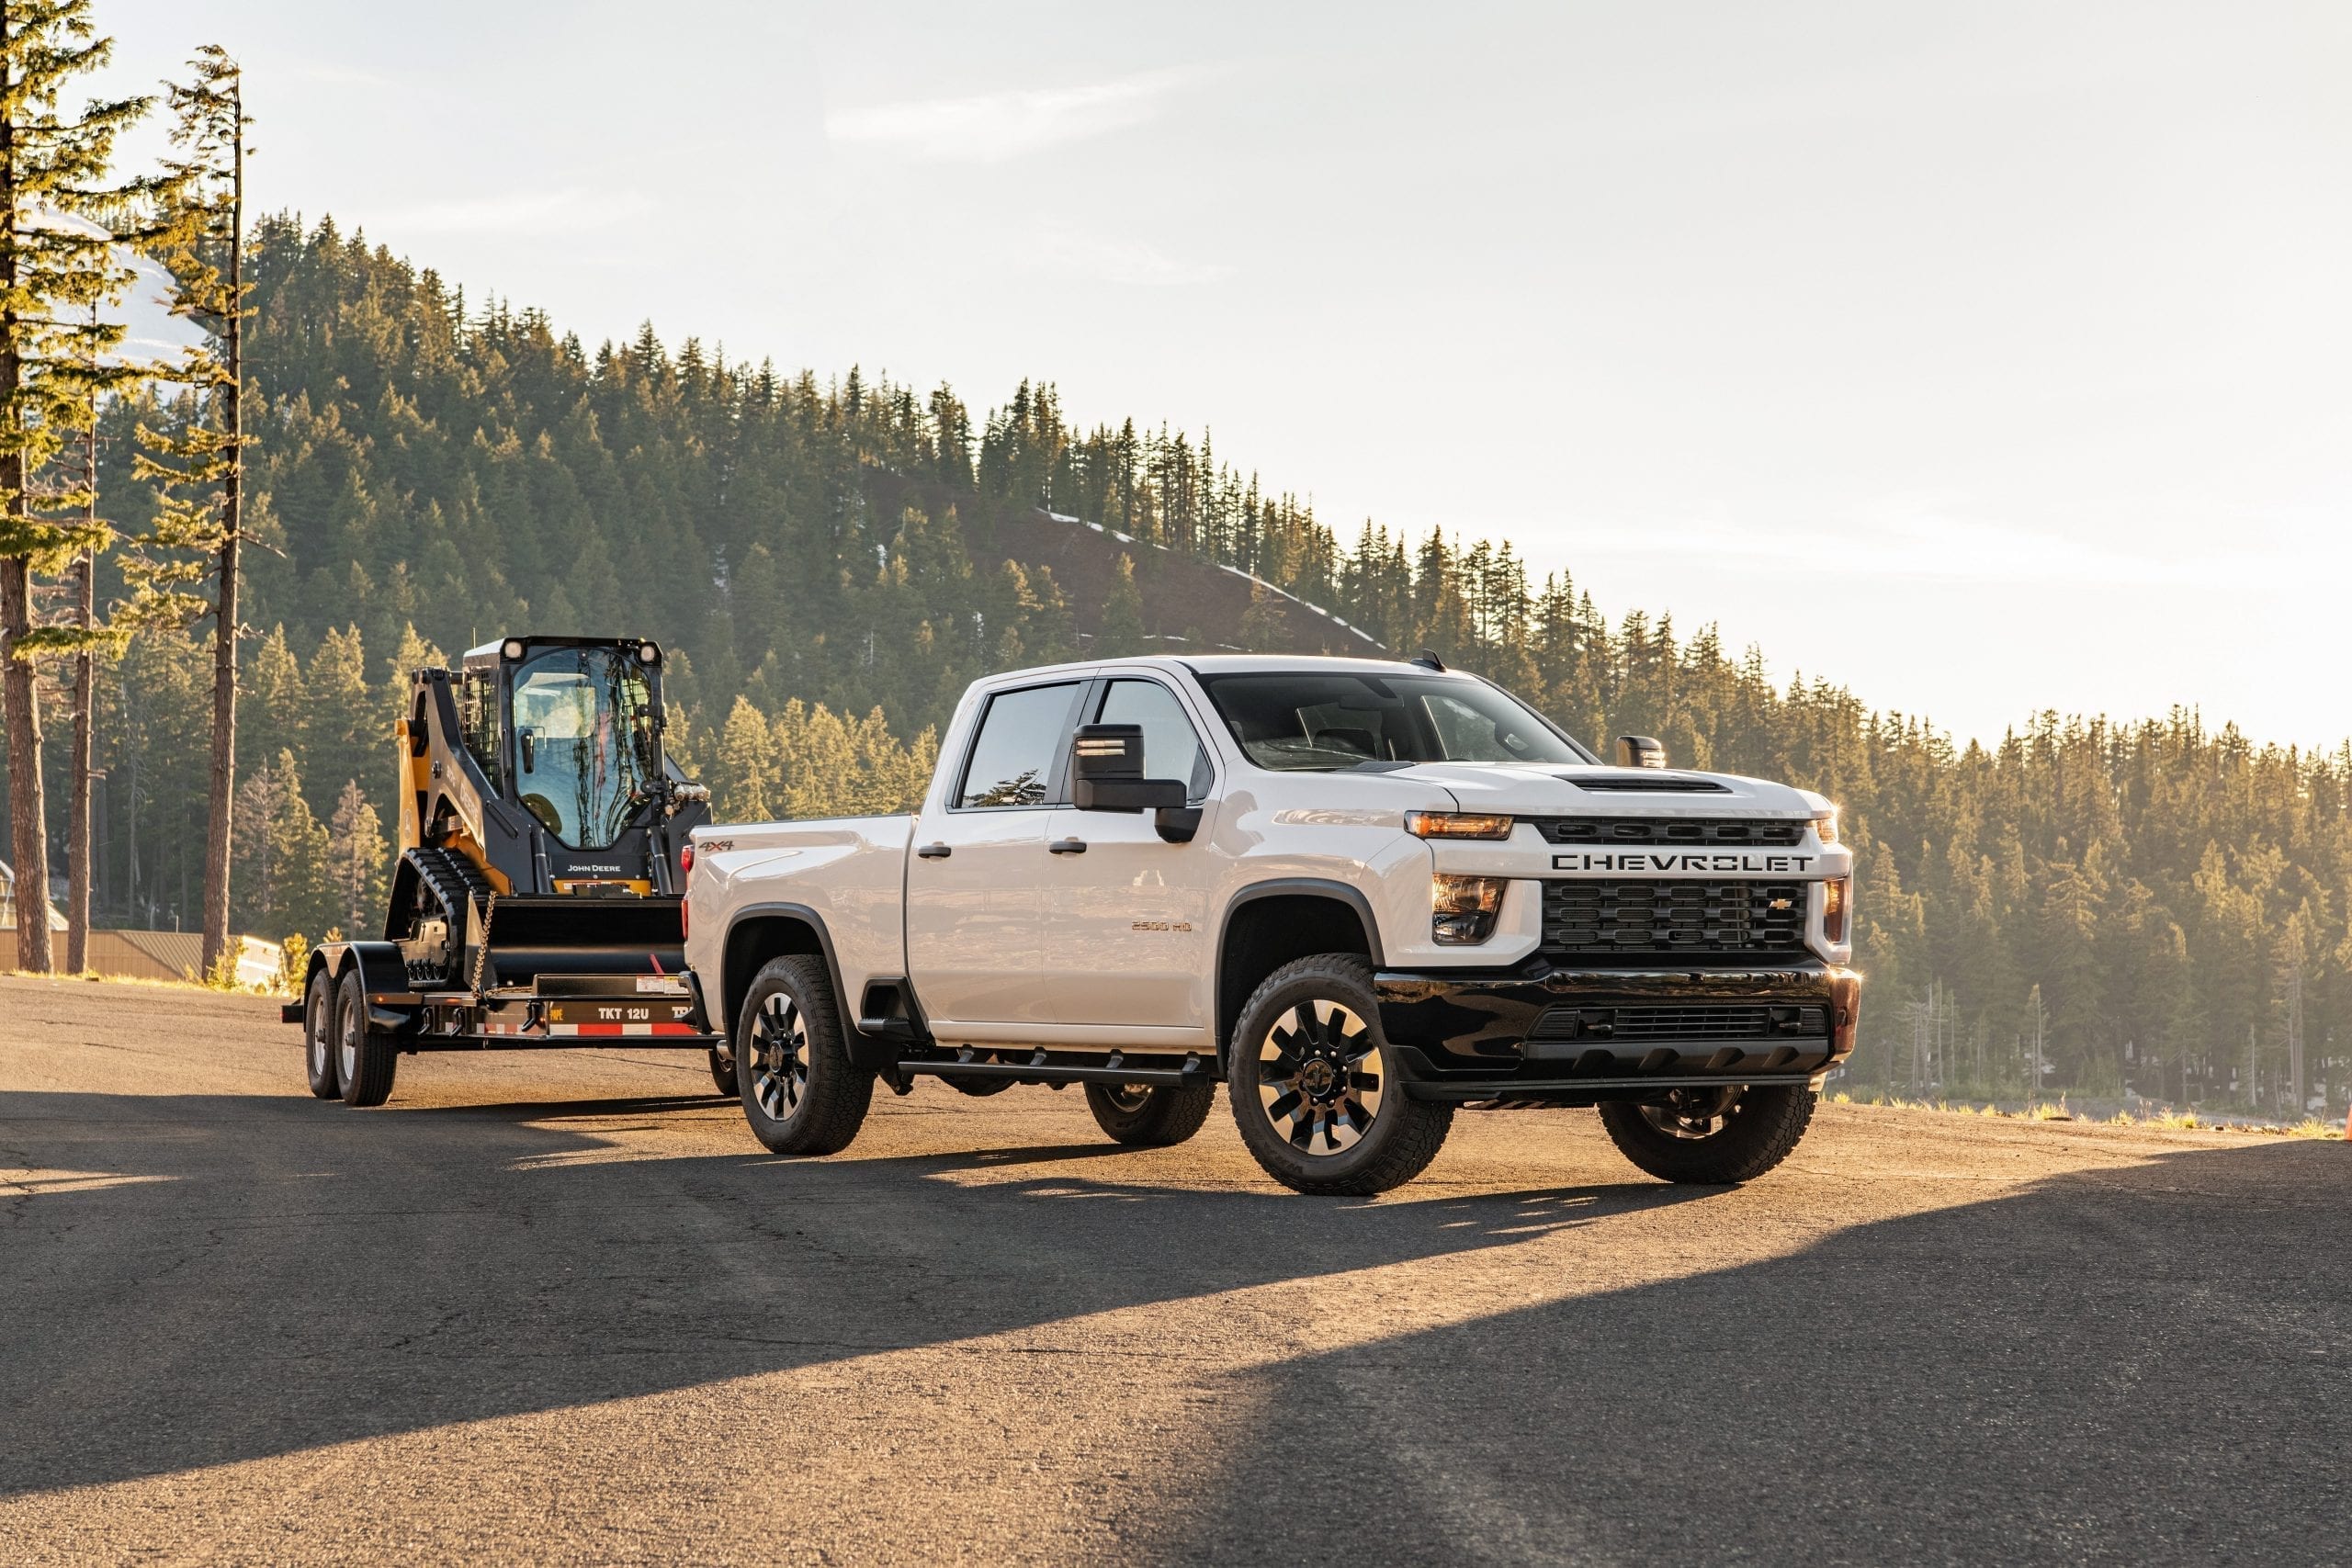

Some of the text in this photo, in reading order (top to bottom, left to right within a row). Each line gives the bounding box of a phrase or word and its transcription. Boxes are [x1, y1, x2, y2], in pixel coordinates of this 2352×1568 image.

[1552, 855, 1813, 872] CHEVROLET
[1132, 921, 1192, 931] 2500 HD
[598, 1008, 649, 1020] TKT 12U
